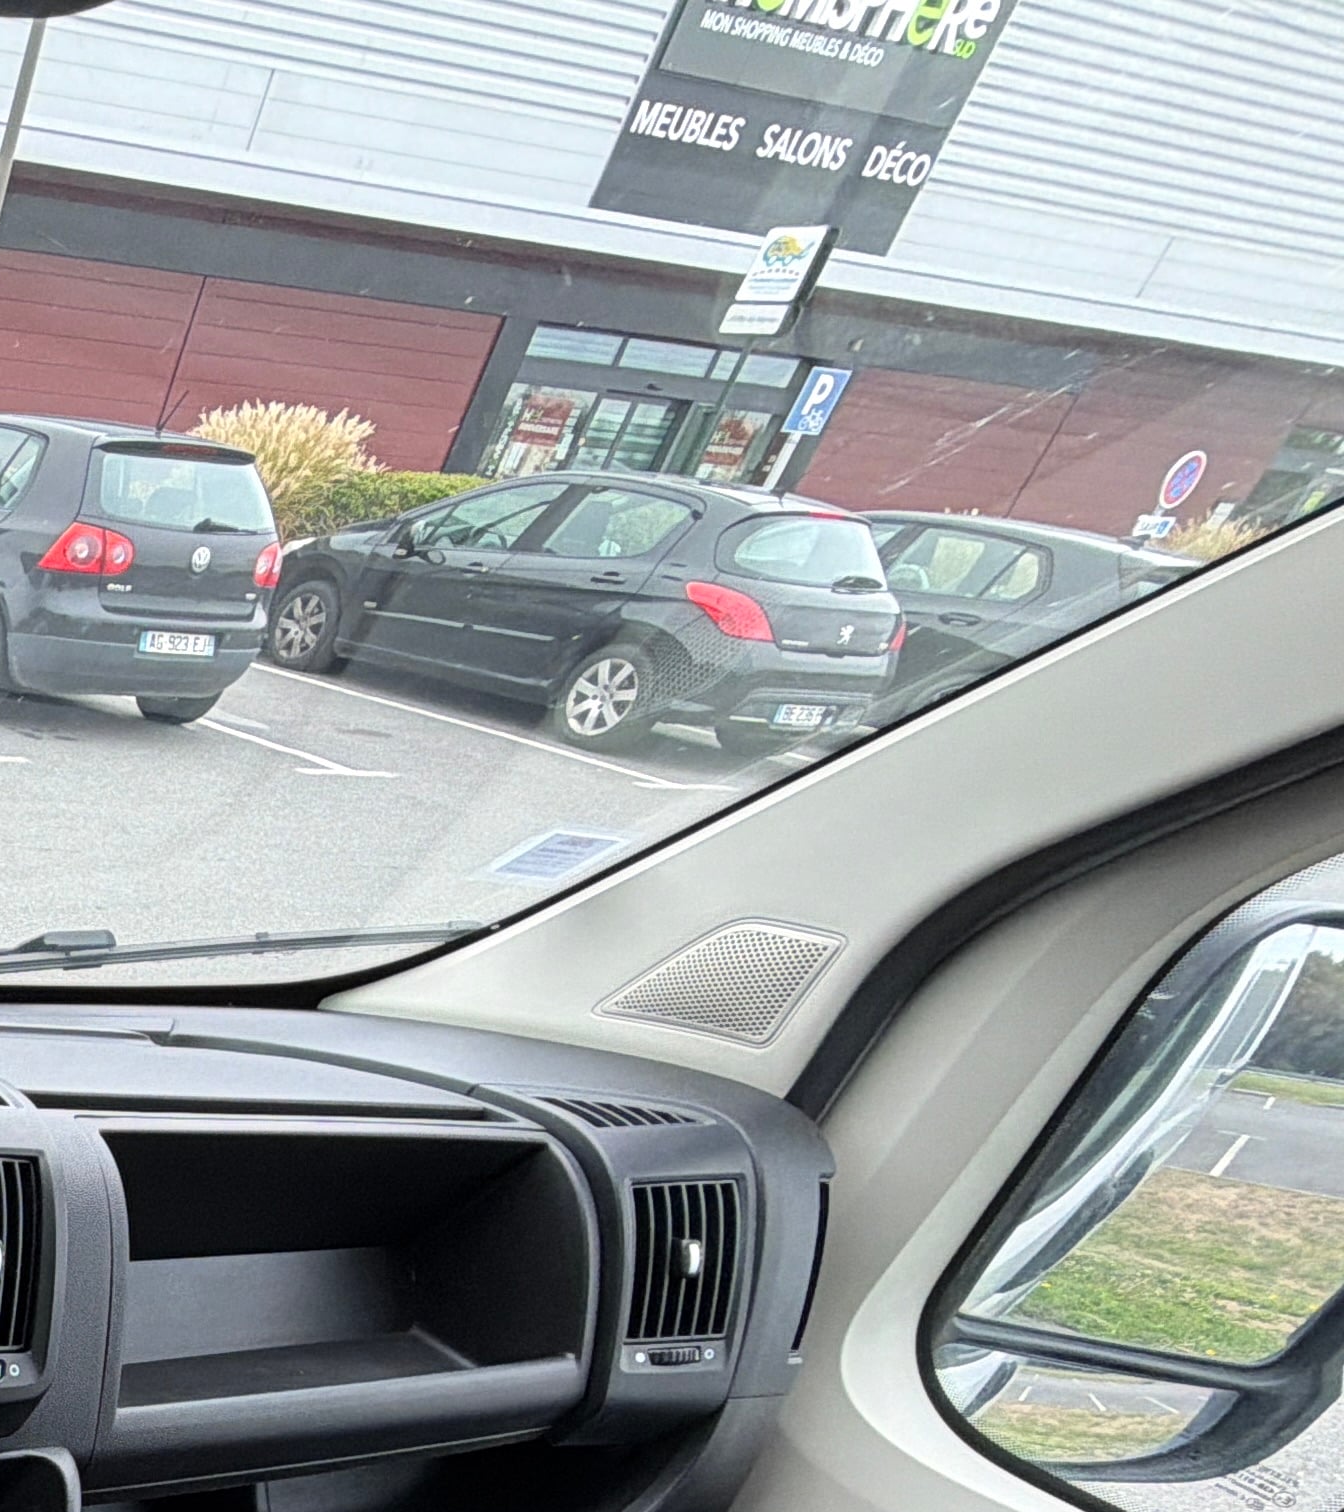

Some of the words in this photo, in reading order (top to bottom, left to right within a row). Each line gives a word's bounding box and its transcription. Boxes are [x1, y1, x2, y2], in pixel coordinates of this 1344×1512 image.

[700, 9, 735, 34] MON
[730, 16, 793, 47] SHOPPING
[789, 30, 842, 58] MEUBLES
[838, 41, 852, 60] &
[848, 41, 884, 67] DÉCO
[953, 38, 976, 59] SUD
[630, 100, 748, 151] MEUBLES
[756, 124, 853, 171] SALONS
[862, 140, 932, 187] DÉCO
[801, 374, 834, 416] P
